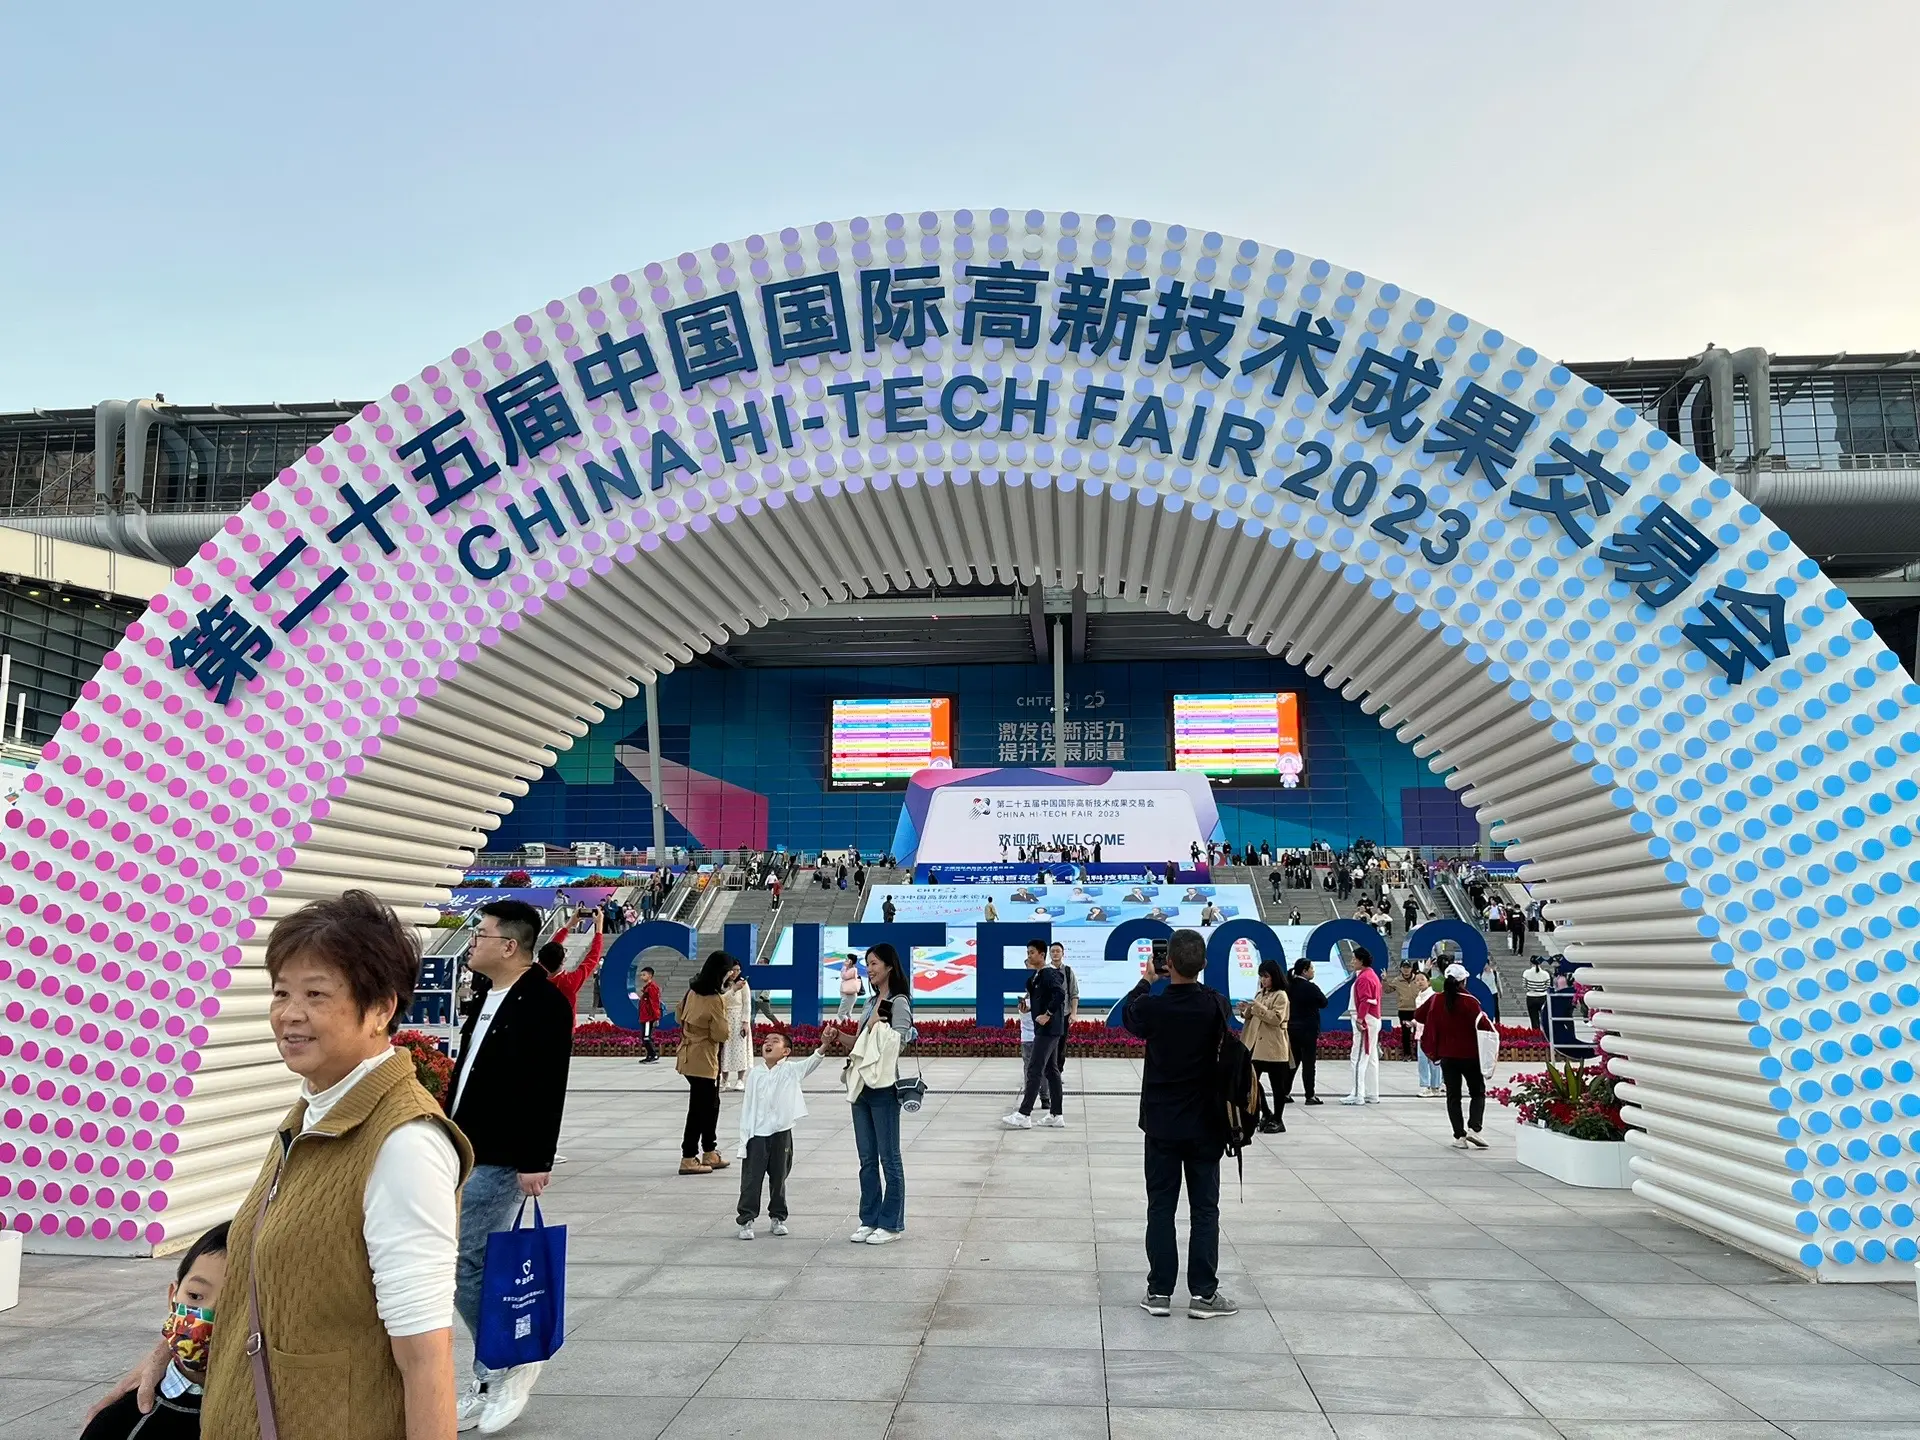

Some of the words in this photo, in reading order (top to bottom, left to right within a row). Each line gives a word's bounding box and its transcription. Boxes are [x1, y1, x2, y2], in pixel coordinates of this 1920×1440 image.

[169, 262, 1791, 704] 第二十五届中国国际高新技术成果交易会
[457, 429, 702, 581] CHINA
[713, 376, 1047, 464] HI-TECH
[1077, 384, 1267, 477] FAIR
[1280, 440, 1472, 566] 2023
[1016, 696, 1052, 707] CHTF
[998, 721, 1124, 742] 激发创新活力
[998, 741, 1126, 762] 提升发展质量
[996, 799, 1155, 808] 第二十五届中国国际高新技术成果交易会
[1029, 810, 1068, 818] HI-TECH
[1072, 810, 1093, 818] FAIR
[1098, 810, 1120, 818] 2023
[998, 833, 1040, 847] 欢迎您
[1052, 833, 1125, 846] WELCOME
[600, 919, 1052, 1030] CHTF
